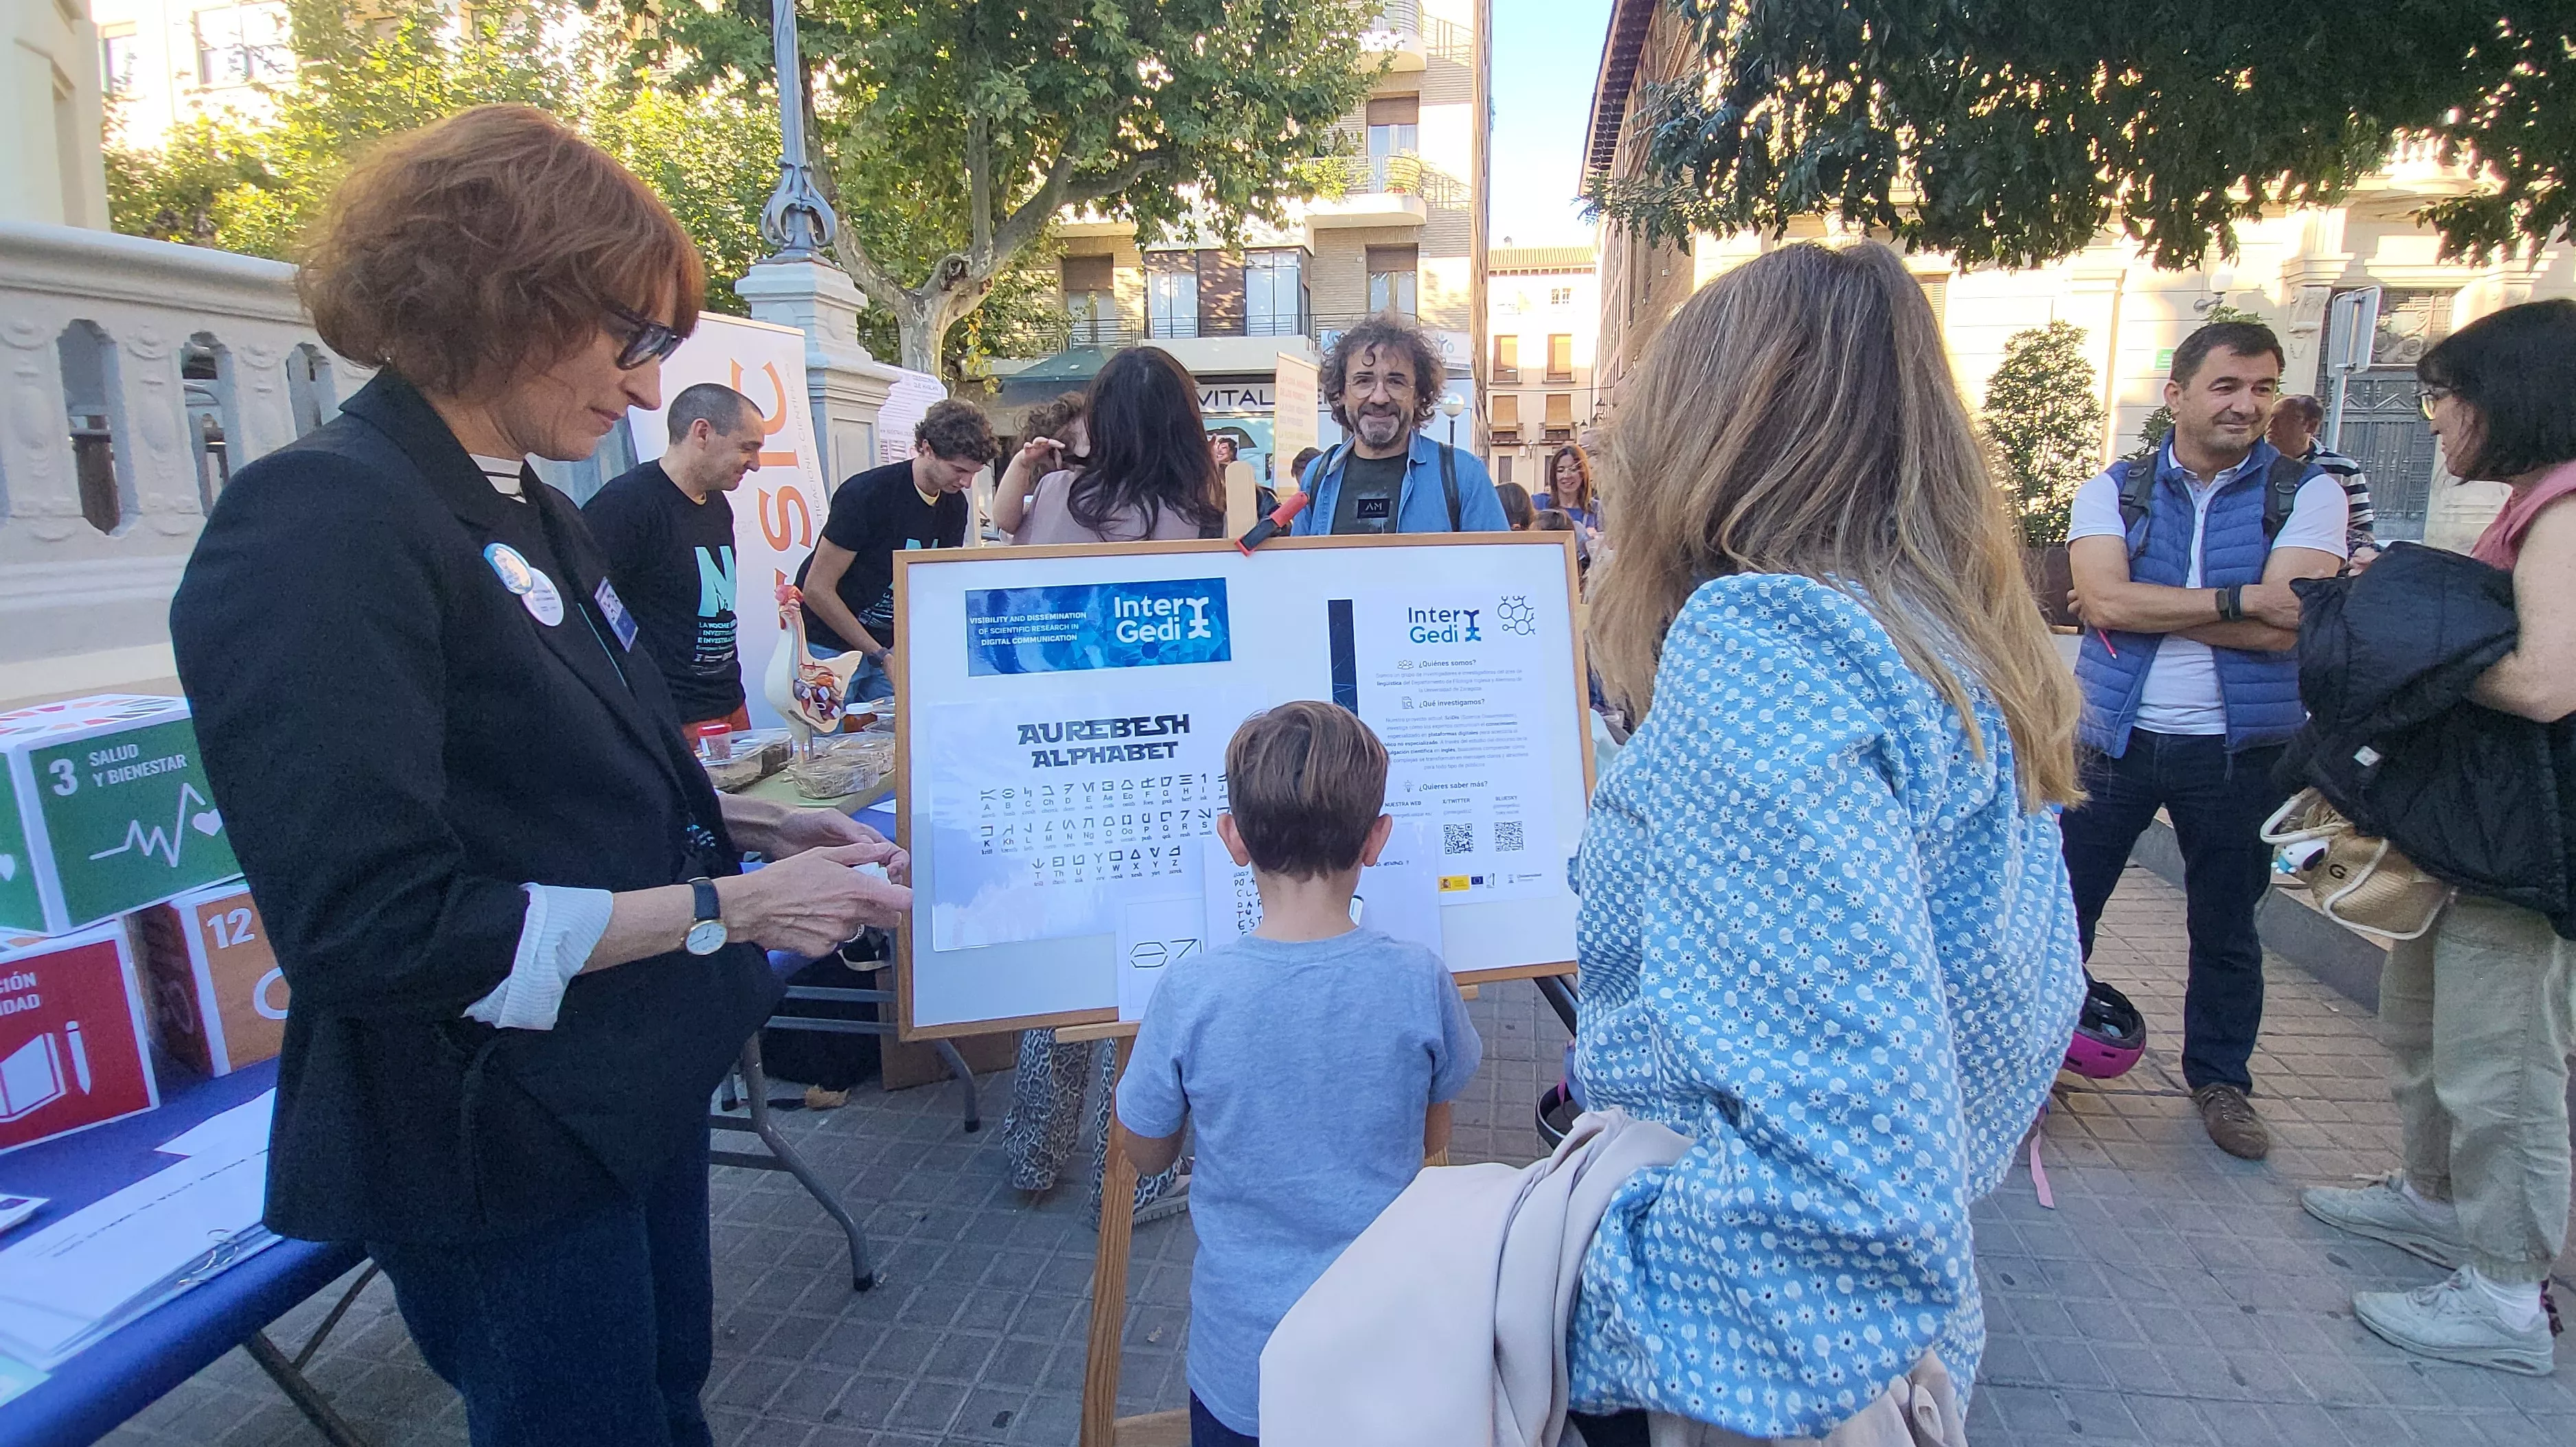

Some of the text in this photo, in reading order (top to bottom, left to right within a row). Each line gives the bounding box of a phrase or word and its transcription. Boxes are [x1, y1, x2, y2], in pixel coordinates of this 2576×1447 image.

[1365, 502, 1382, 511] AM
[1114, 596, 1186, 618] Inter
[1408, 607, 1460, 623] Inter
[969, 616, 1008, 625] VISIBILITY
[1026, 612, 1087, 621] DISSEMINATION
[990, 625, 1030, 634] SCIENTIFIC
[1031, 623, 1070, 632] RESEARCH
[1116, 617, 1181, 643] Gedi
[1410, 624, 1458, 643] Gedi
[981, 634, 1077, 646] DIGITAL COMMUNICATION
[1419, 698, 1484, 708] ¿Qué investigamos?
[1017, 713, 1190, 745] AUREBESH
[89, 744, 139, 767] SALUD
[1031, 741, 1179, 768] ALPHABET
[49, 759, 78, 796] 3
[92, 754, 187, 787] Y BIENESTAR
[1419, 783, 1448, 791] ¿Quieres
[2330, 864, 2347, 879] G
[207, 907, 255, 949] 12
